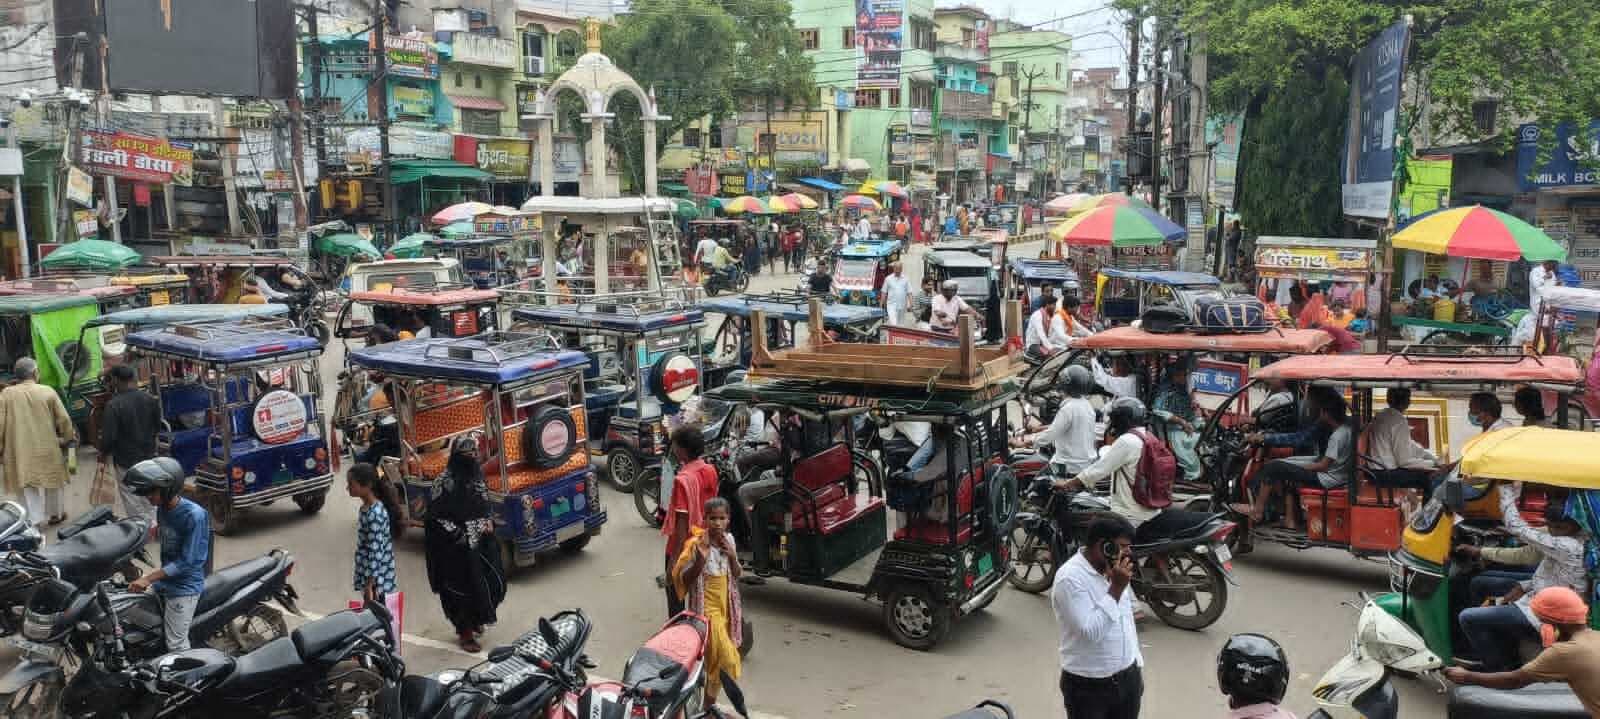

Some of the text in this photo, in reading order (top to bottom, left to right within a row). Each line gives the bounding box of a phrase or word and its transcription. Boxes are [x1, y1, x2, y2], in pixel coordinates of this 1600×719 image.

[134, 153, 174, 172] डोसा
[1534, 172, 1567, 184] MILK
[817, 393, 845, 405] CITY
